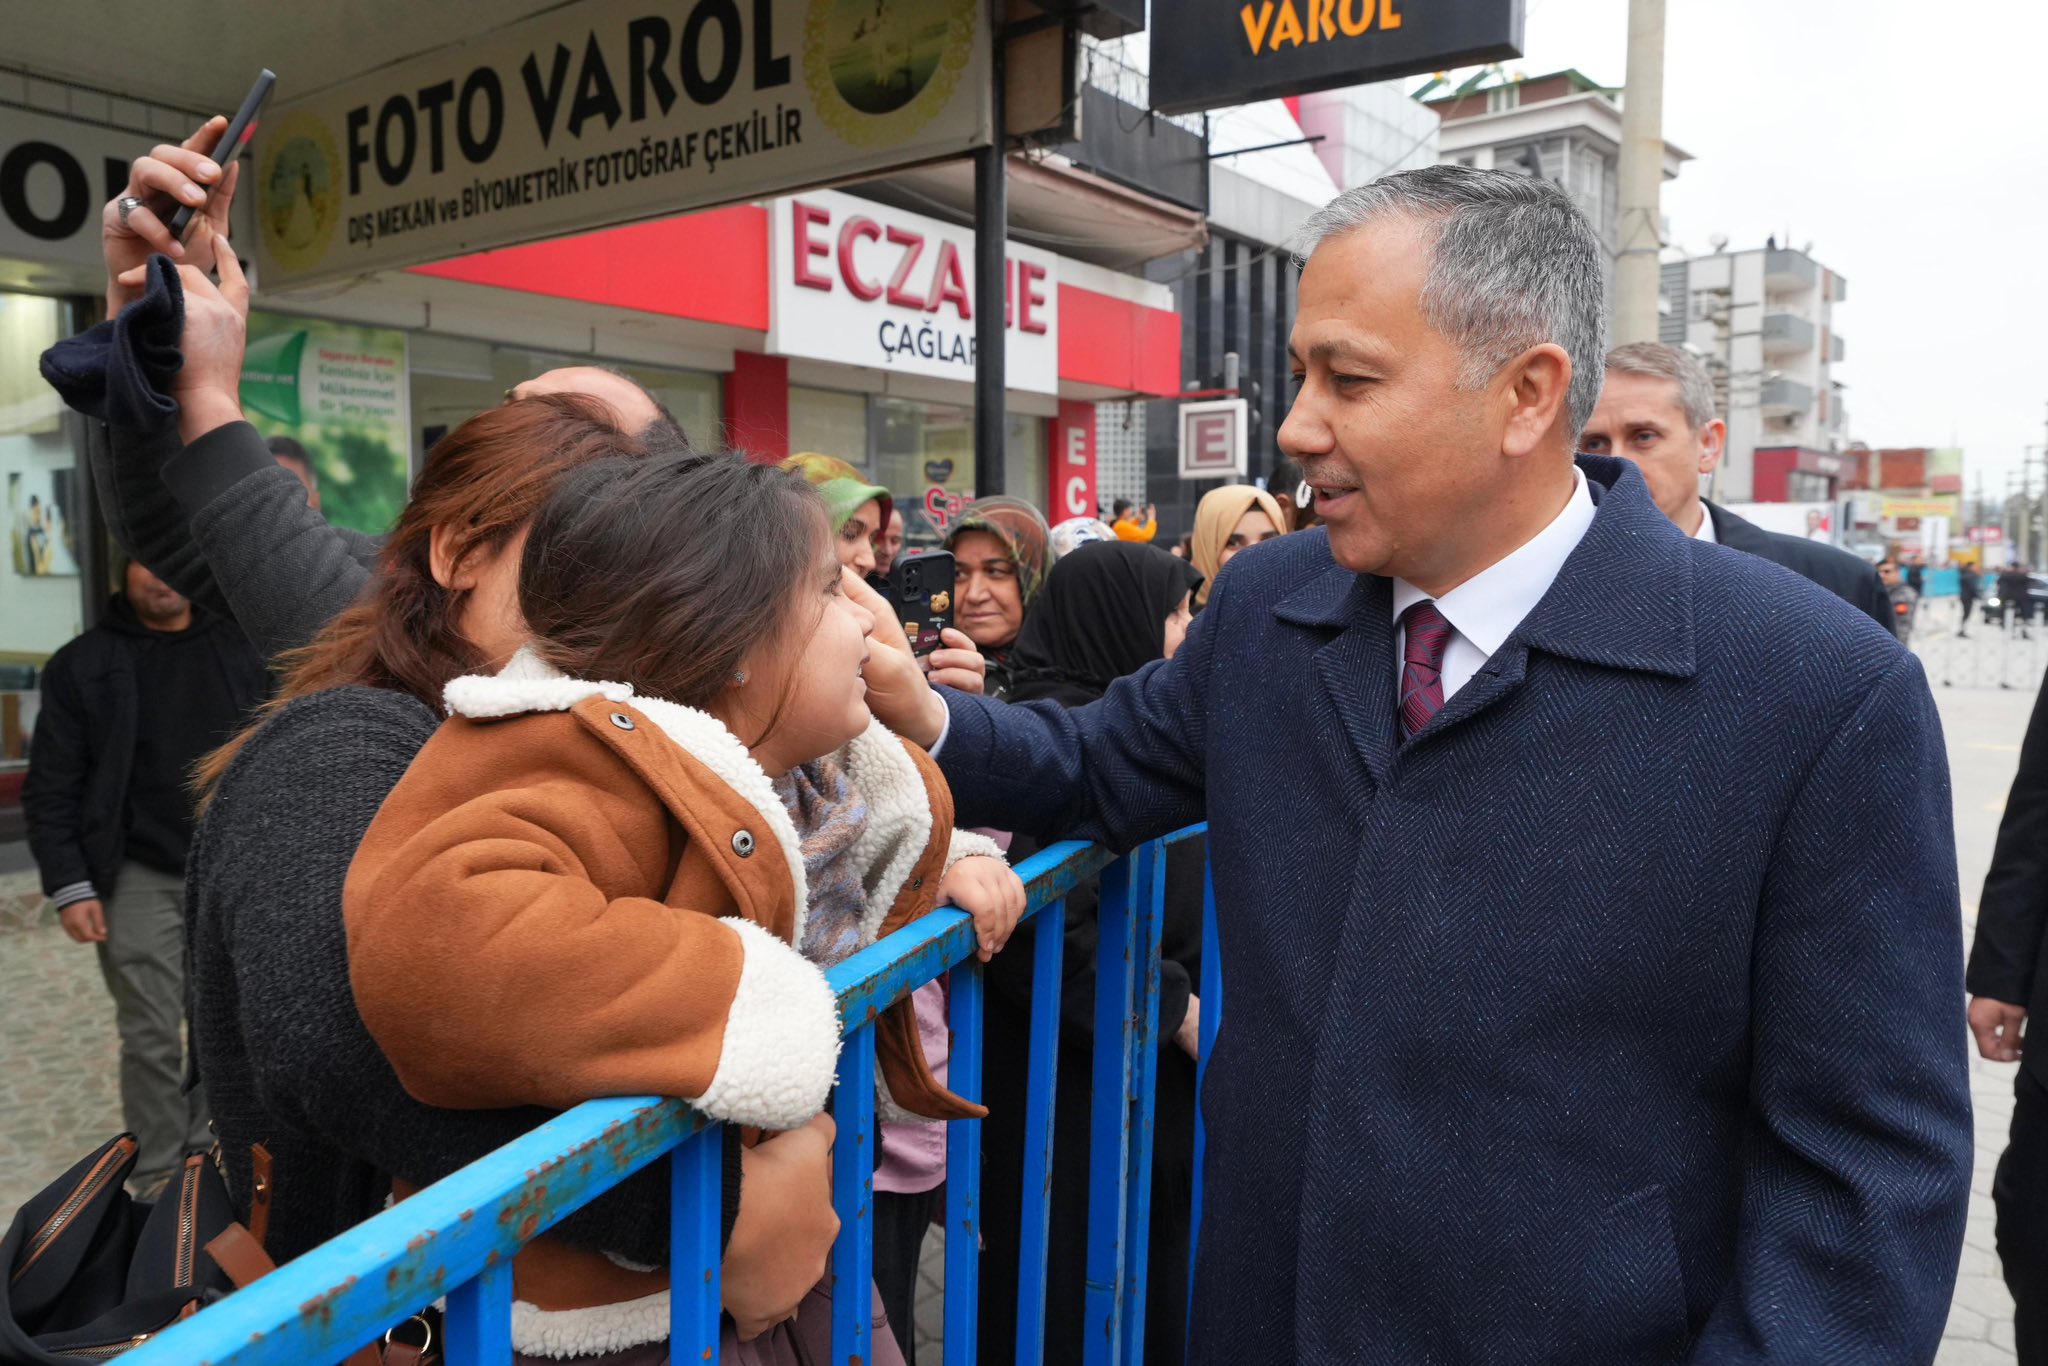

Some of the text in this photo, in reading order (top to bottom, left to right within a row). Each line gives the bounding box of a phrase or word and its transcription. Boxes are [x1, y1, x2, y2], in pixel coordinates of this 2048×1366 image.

[1240, 0, 1401, 56] VAROL
[346, 0, 792, 196] FOTO VAROL
[349, 103, 803, 247] DIŞ MEKAN ve BİYOMETRİK FOTOĞRAF ÇEKİLİR
[792, 199, 1047, 336] ECZAE
[1195, 419, 1227, 462] E
